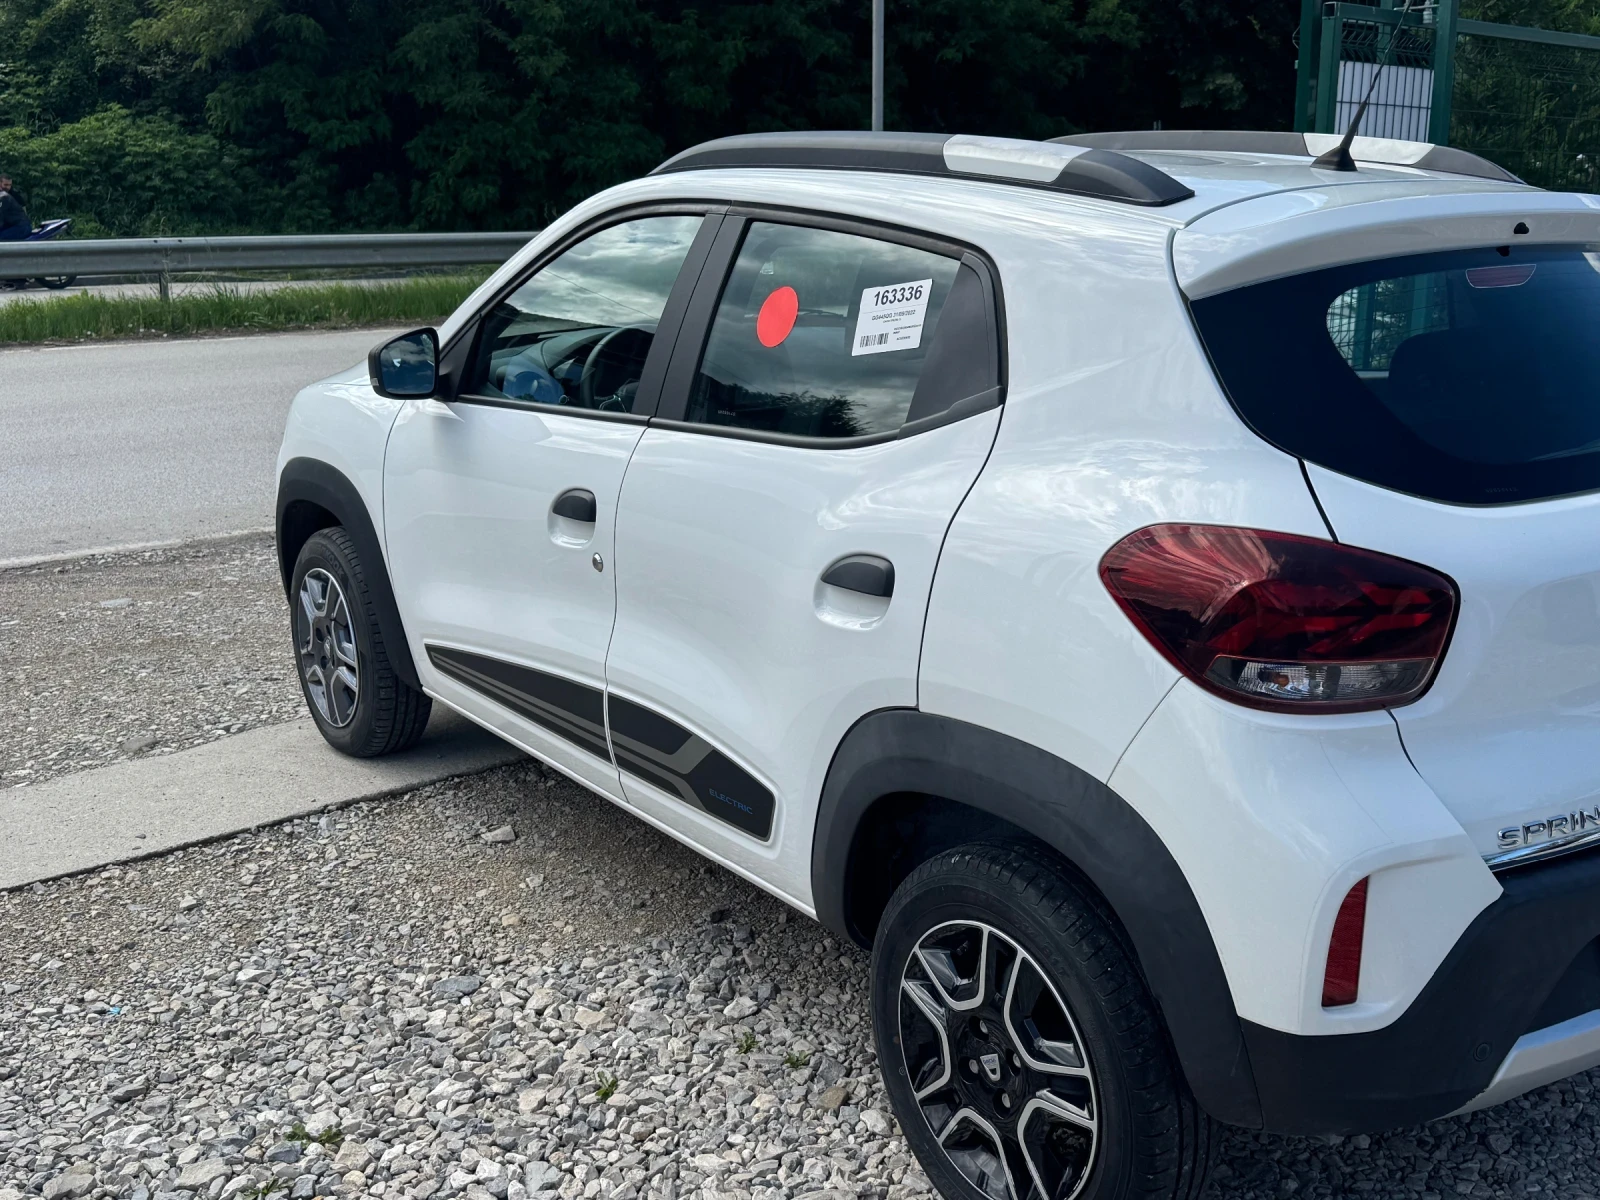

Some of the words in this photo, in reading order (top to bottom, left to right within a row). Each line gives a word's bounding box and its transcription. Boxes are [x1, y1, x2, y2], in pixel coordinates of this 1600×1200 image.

[874, 285, 923, 306] 163336
[708, 788, 753, 815] ELECTRIC
[1497, 804, 1600, 850] SPRIN
